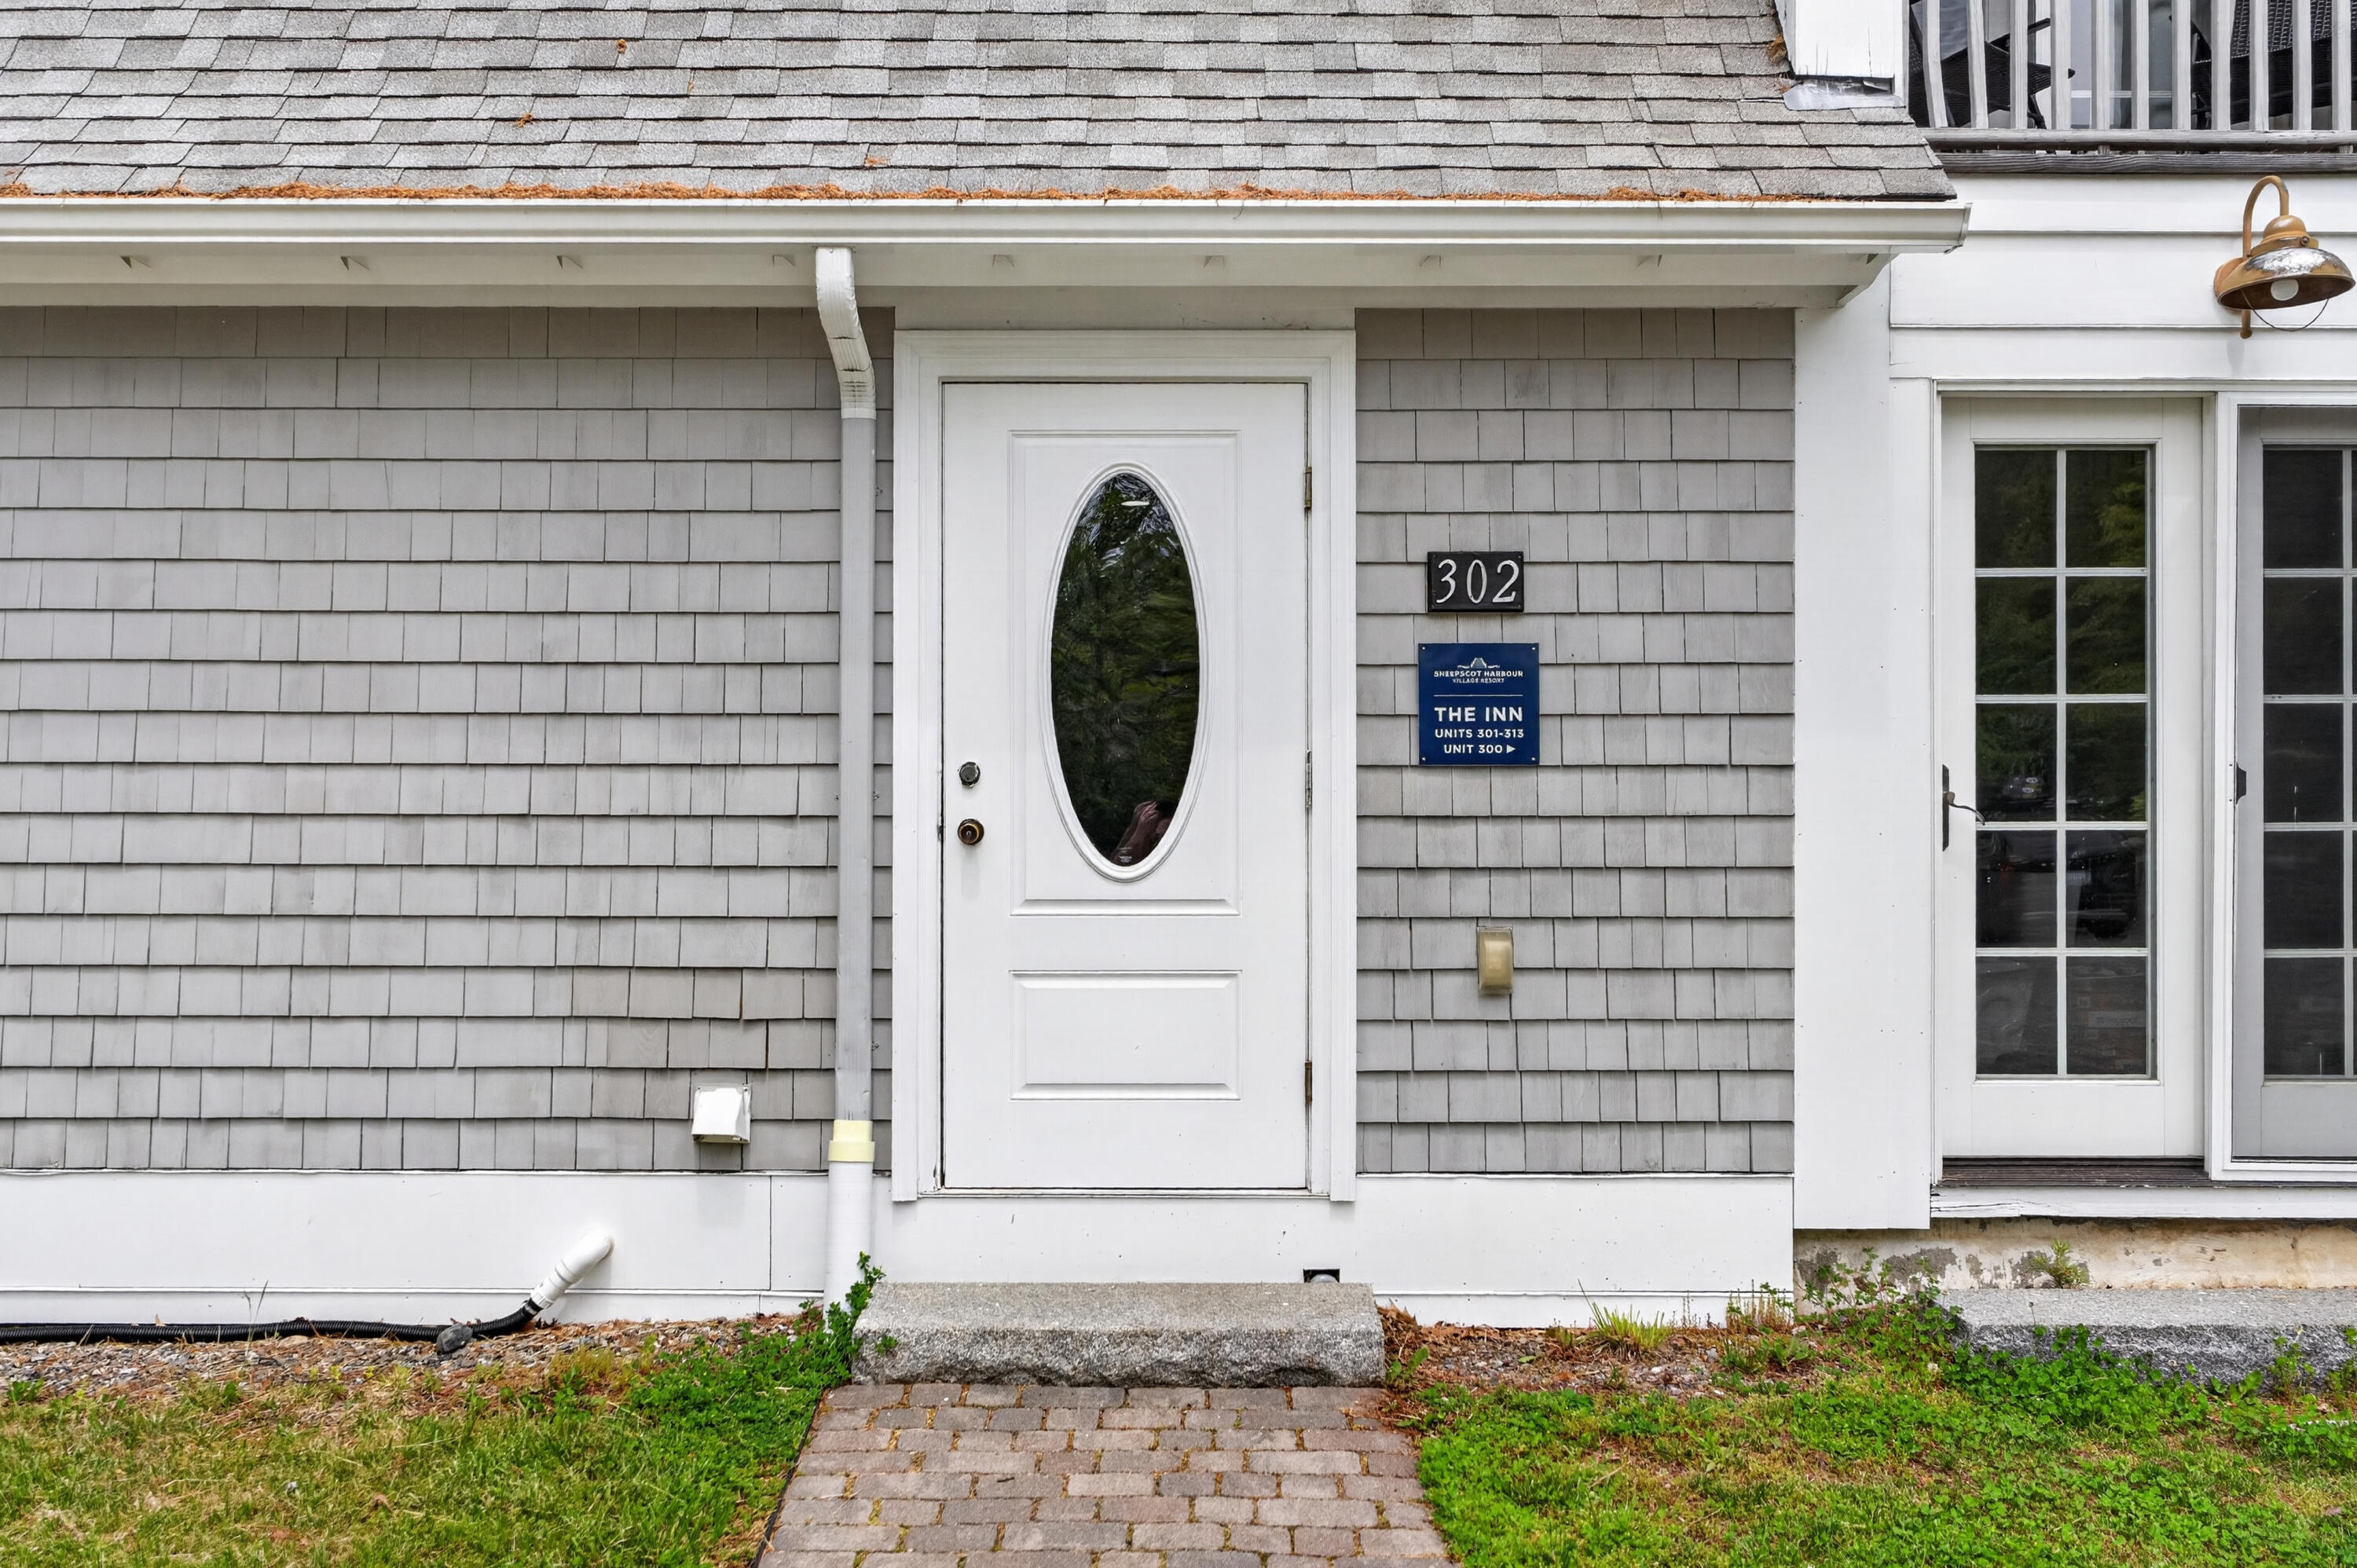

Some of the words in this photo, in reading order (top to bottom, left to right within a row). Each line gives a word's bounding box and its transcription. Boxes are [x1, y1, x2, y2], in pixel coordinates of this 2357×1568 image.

[1435, 559, 1519, 604] 302
[1434, 706, 1476, 722] THE
[1485, 706, 1523, 722] INN
[1435, 728, 1473, 738] UNITS
[1477, 728, 1524, 738] 301-313
[1443, 744, 1475, 754] UNIT
[1478, 744, 1503, 754] 300
